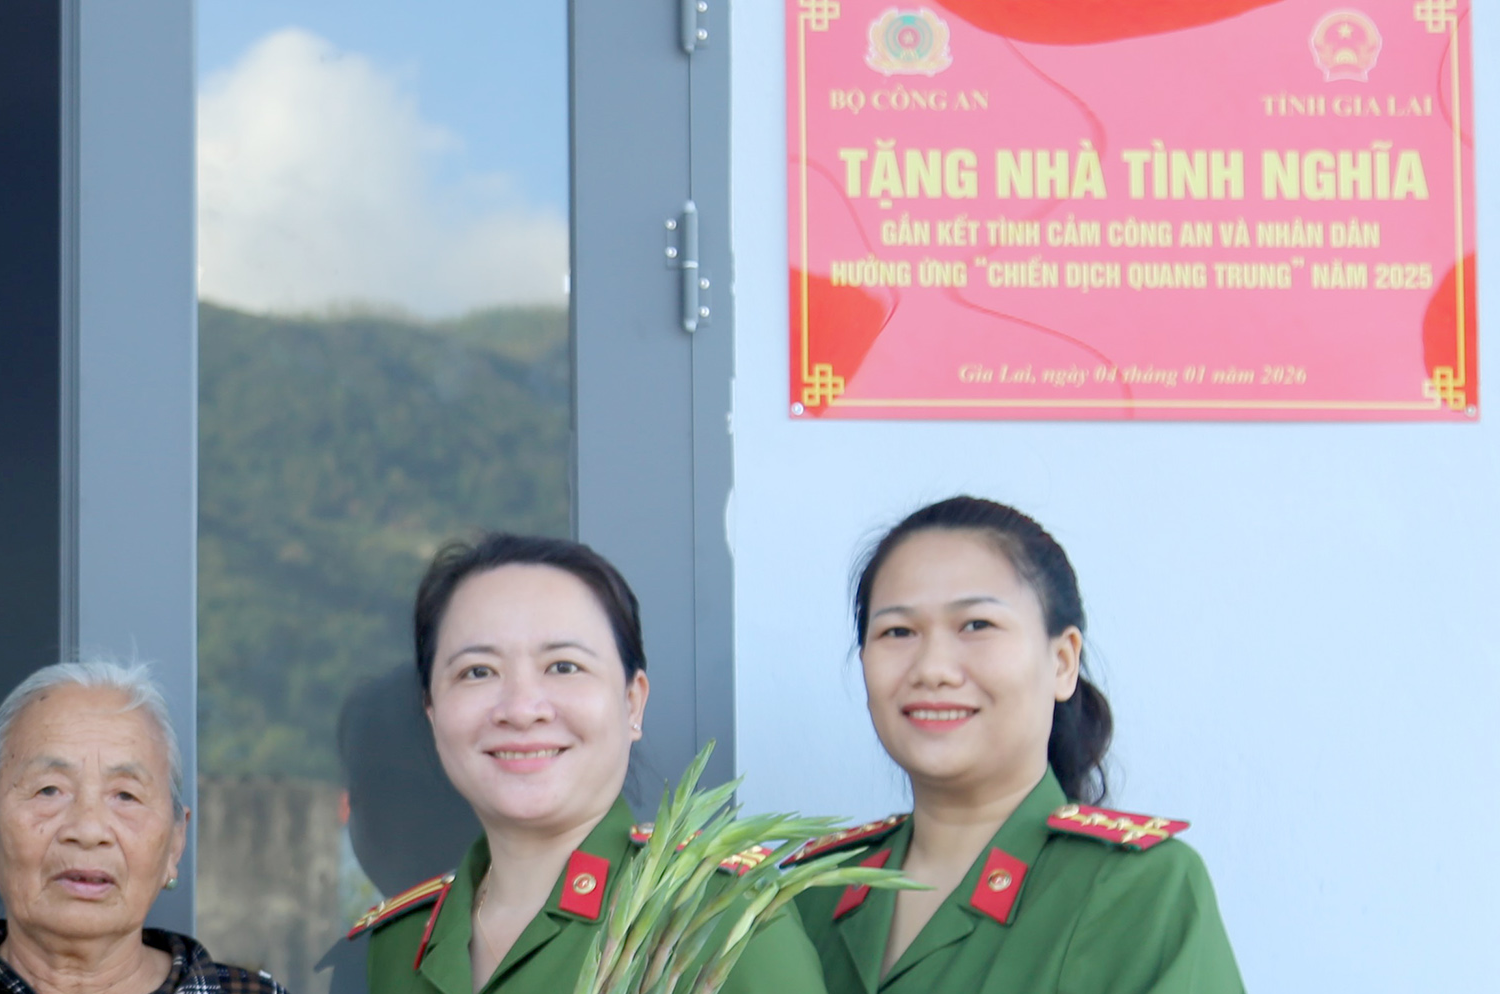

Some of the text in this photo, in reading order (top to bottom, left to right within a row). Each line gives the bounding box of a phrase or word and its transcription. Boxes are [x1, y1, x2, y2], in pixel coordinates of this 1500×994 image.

[830, 84, 989, 115] BỘ CÔNG AN
[1332, 95, 1382, 117] GIA
[1387, 95, 1433, 117] LAI
[839, 137, 1430, 209] TẶNG NHÀ TÌNH NGHĨA
[881, 212, 1381, 249] GẮN KẾT TÌNH CẢM CÔNG AN VÀ NHÂN DÂN
[831, 253, 912, 288] HƯỞNG
[919, 255, 968, 288] ỨNG
[1065, 261, 1121, 293] DỊCH
[1128, 261, 1207, 292] QUANG
[1311, 257, 1368, 290] NĂM
[1374, 261, 1434, 290] 2025
[959, 363, 1308, 389] Gia Lai, ngày 04 tháng 01 năm 2026
